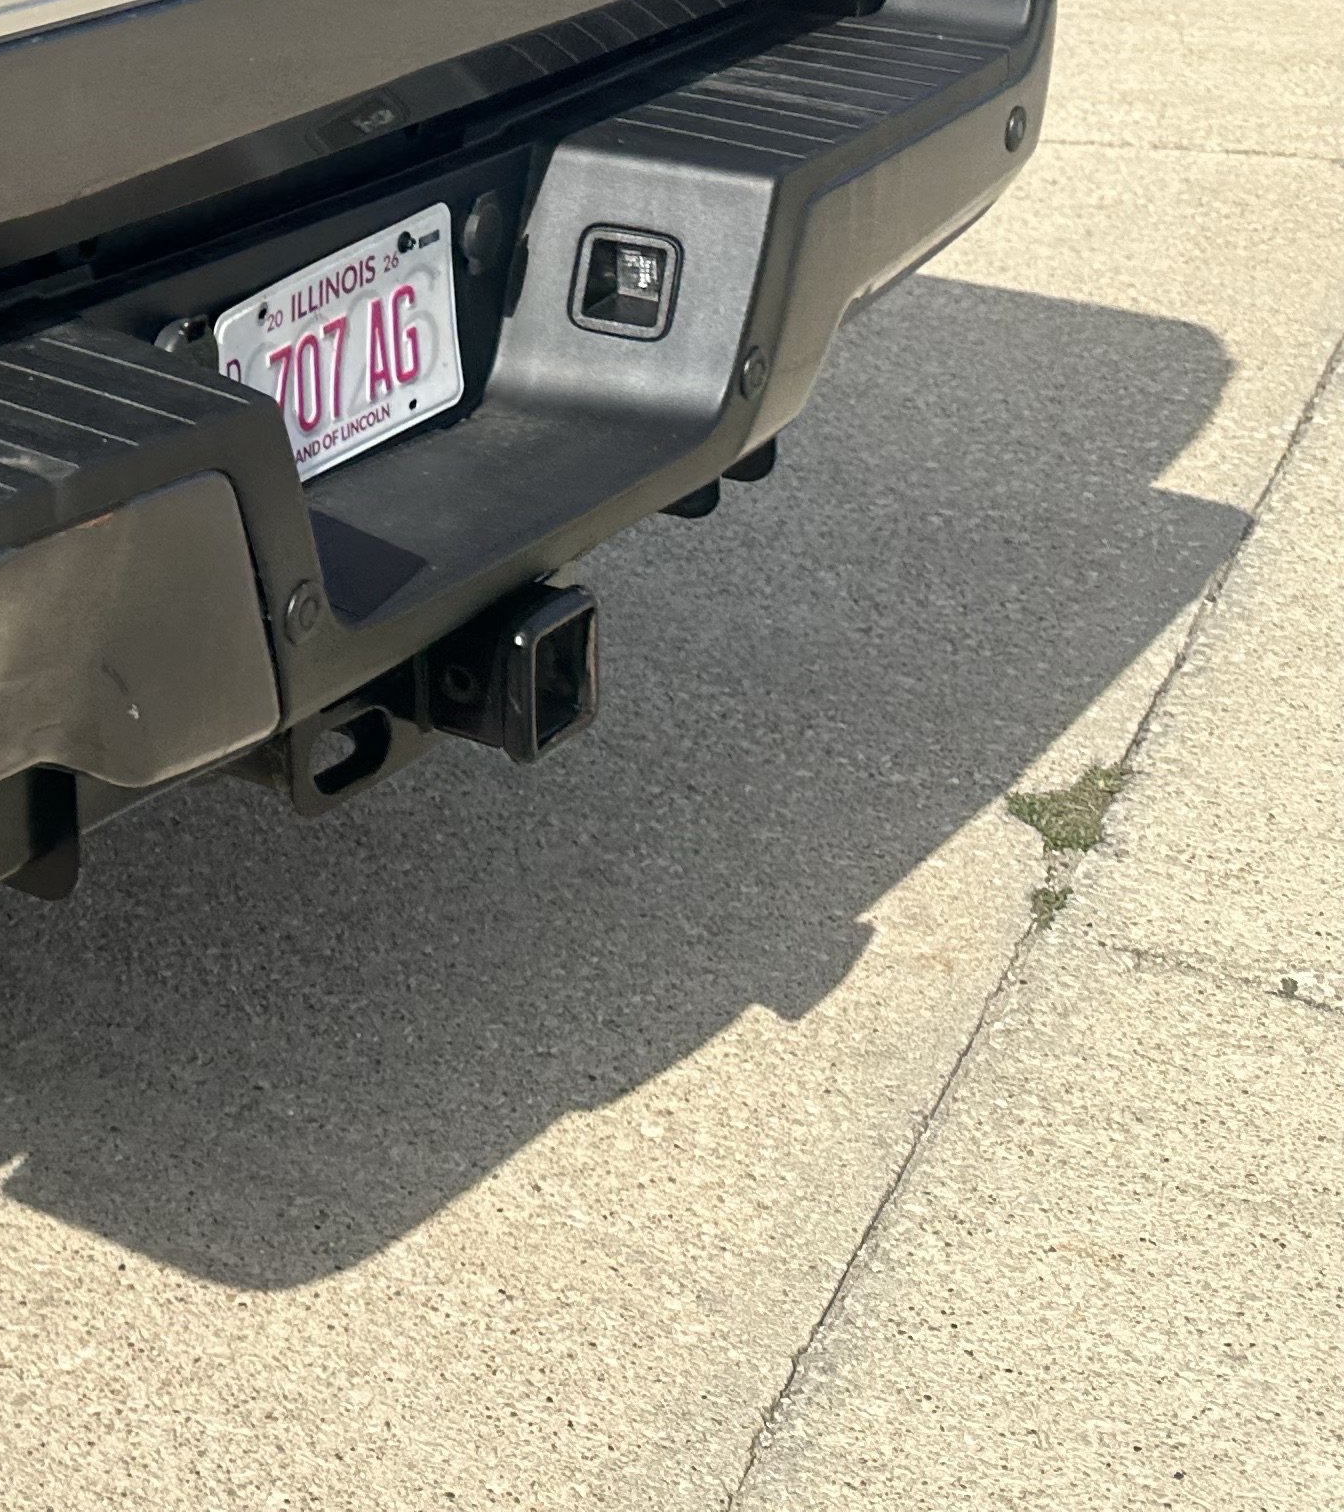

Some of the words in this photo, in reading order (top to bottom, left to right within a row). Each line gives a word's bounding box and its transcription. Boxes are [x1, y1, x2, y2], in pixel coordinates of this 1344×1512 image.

[267, 309, 283, 333] 20
[290, 255, 376, 322] ILLINOIS
[383, 253, 400, 275] 26
[267, 314, 348, 433] 707
[366, 285, 419, 403] AG
[296, 439, 321, 464] AND
[322, 429, 339, 450] OF
[340, 402, 391, 441] LINCOLN
